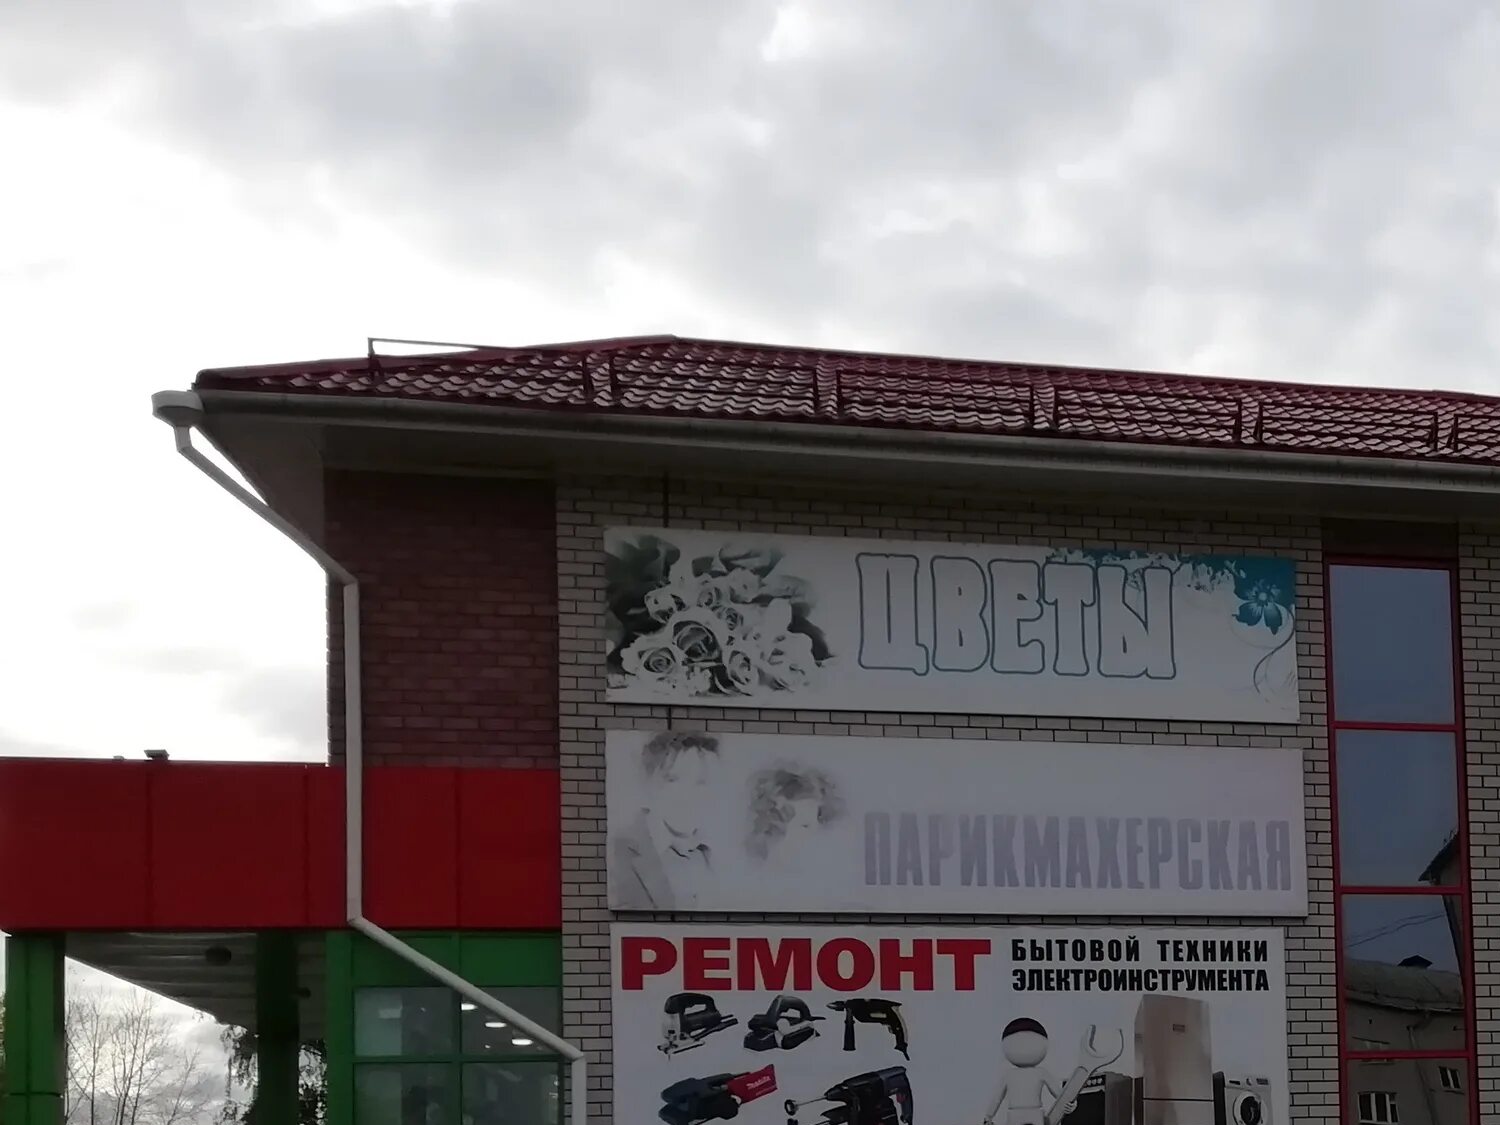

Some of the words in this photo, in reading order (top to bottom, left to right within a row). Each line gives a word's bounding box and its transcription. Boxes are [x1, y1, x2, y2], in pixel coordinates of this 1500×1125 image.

[855, 552, 1177, 680] ЦВЕТЫ
[864, 811, 1292, 891] ПАРИКМАХЕРСКАЯ
[621, 937, 991, 991] РЕМОНТ
[1011, 935, 1140, 962] БЫТОВОЙ
[1157, 939, 1268, 962] ТЕХНИКИ
[1012, 968, 1270, 991] ЭЛЕКТРОИНСТРУМЕНТА
